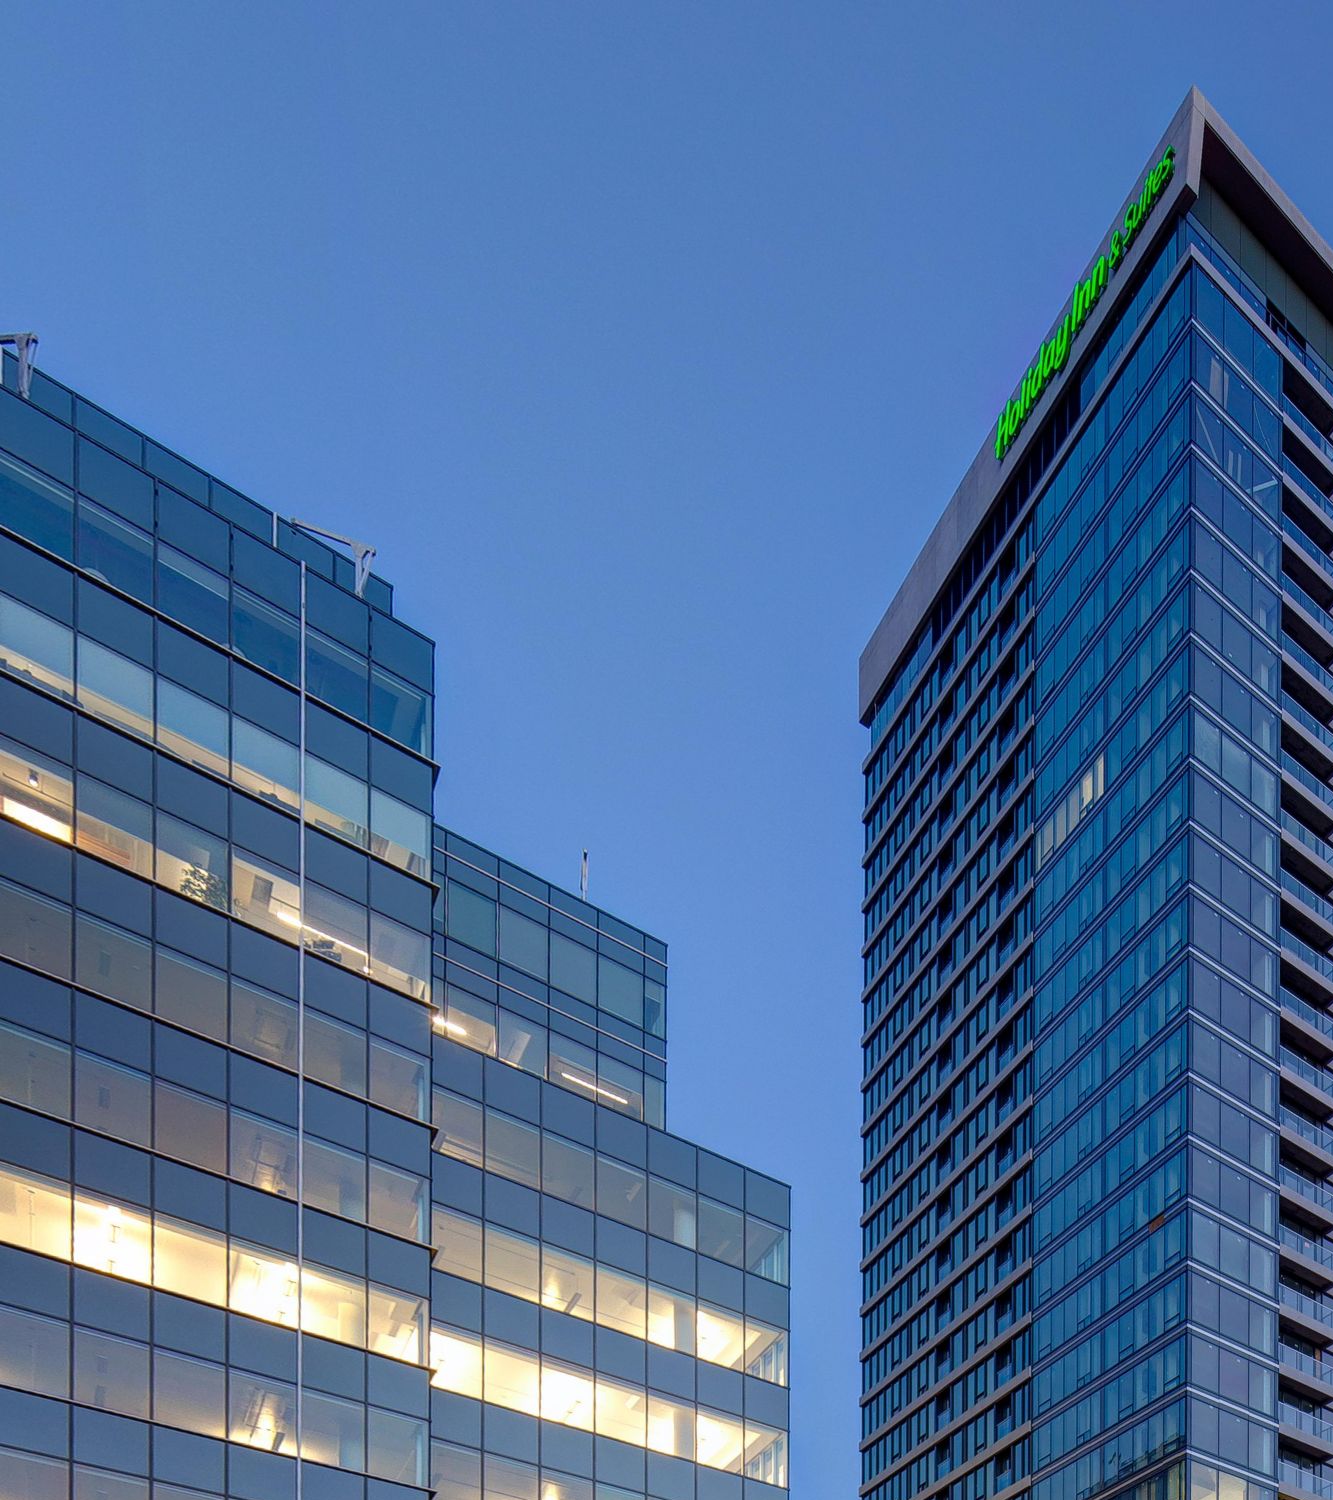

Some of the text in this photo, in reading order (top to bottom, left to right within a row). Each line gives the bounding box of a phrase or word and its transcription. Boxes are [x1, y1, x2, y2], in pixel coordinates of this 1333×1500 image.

[994, 144, 1176, 461] Holiday Inn & Suites
